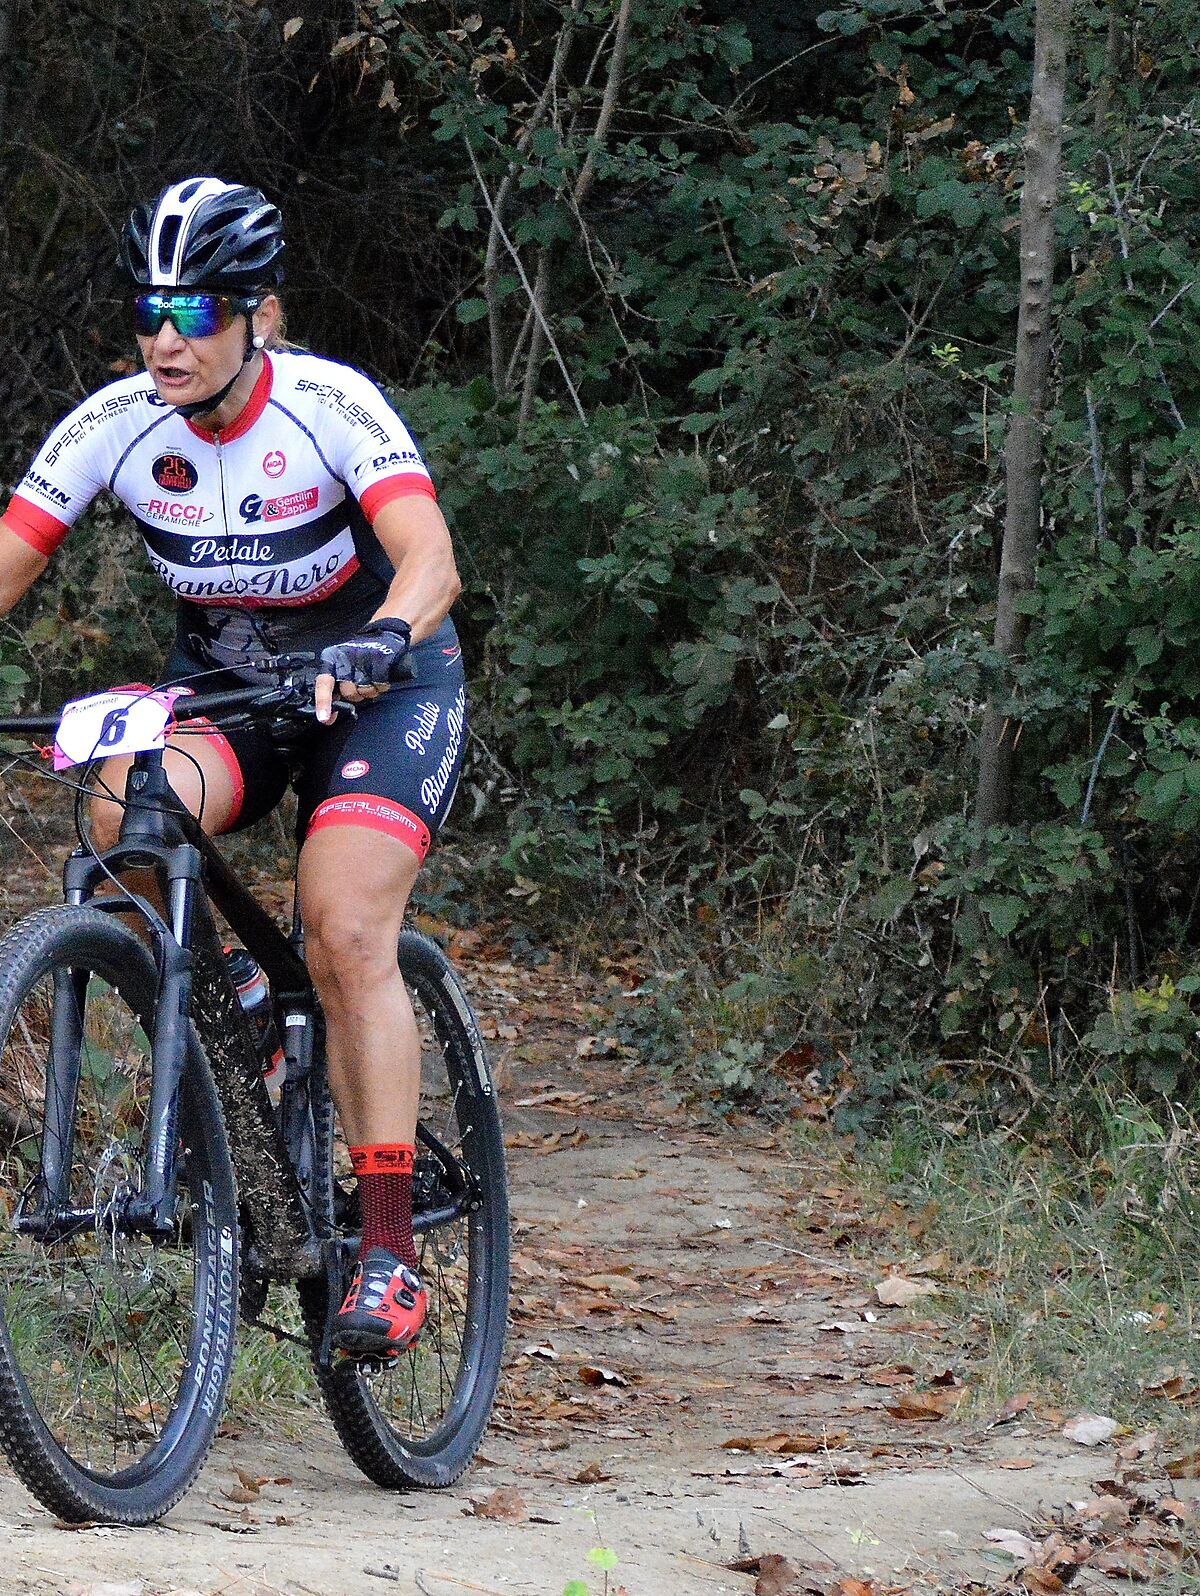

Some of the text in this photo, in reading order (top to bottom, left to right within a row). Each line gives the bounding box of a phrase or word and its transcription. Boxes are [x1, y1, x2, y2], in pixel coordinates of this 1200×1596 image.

[97, 407, 129, 424] FITNESS
[146, 511, 201, 527] CERAMICHE
[147, 499, 204, 520] RICCI
[282, 503, 308, 516] Zappi
[189, 539, 275, 563] Pedale
[99, 708, 129, 747] 6
[405, 701, 441, 756] Pedale
[318, 801, 418, 833] SPECIALISSIMA
[193, 1179, 218, 1389] BONTRAGER
[201, 1249, 233, 1418] BONTRAGER
